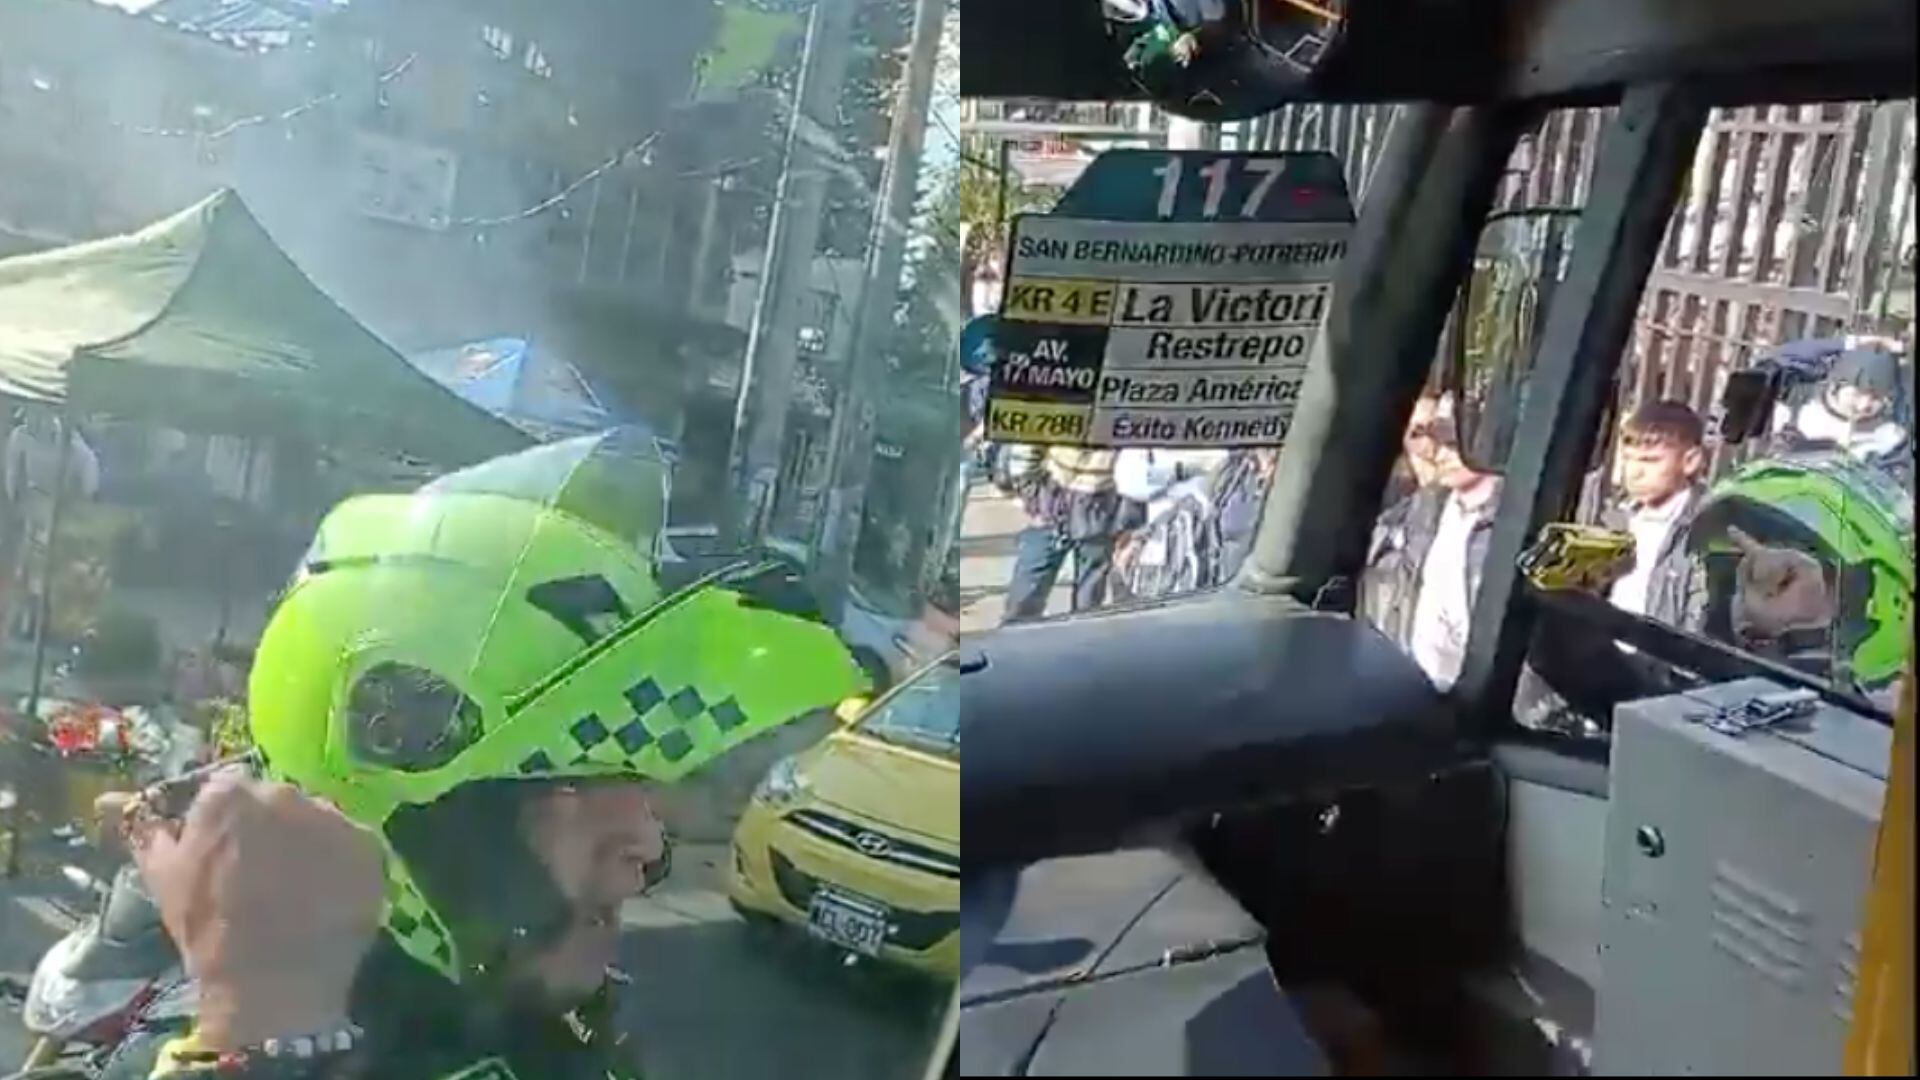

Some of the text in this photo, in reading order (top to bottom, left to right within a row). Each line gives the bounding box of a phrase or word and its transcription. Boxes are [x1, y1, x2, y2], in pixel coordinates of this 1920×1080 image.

[1153, 156, 1285, 217] 117
[1018, 235, 1068, 260] SAN
[1010, 285, 1112, 315] KR 4 E
[1122, 287, 1174, 323] La
[1033, 338, 1068, 362] AV.
[1146, 331, 1304, 364] Restrepo
[1028, 364, 1095, 389] MAYO
[1100, 375, 1180, 402] Plaza
[992, 407, 1027, 433] KR
[1112, 411, 1291, 441] Éxito Kennedy
